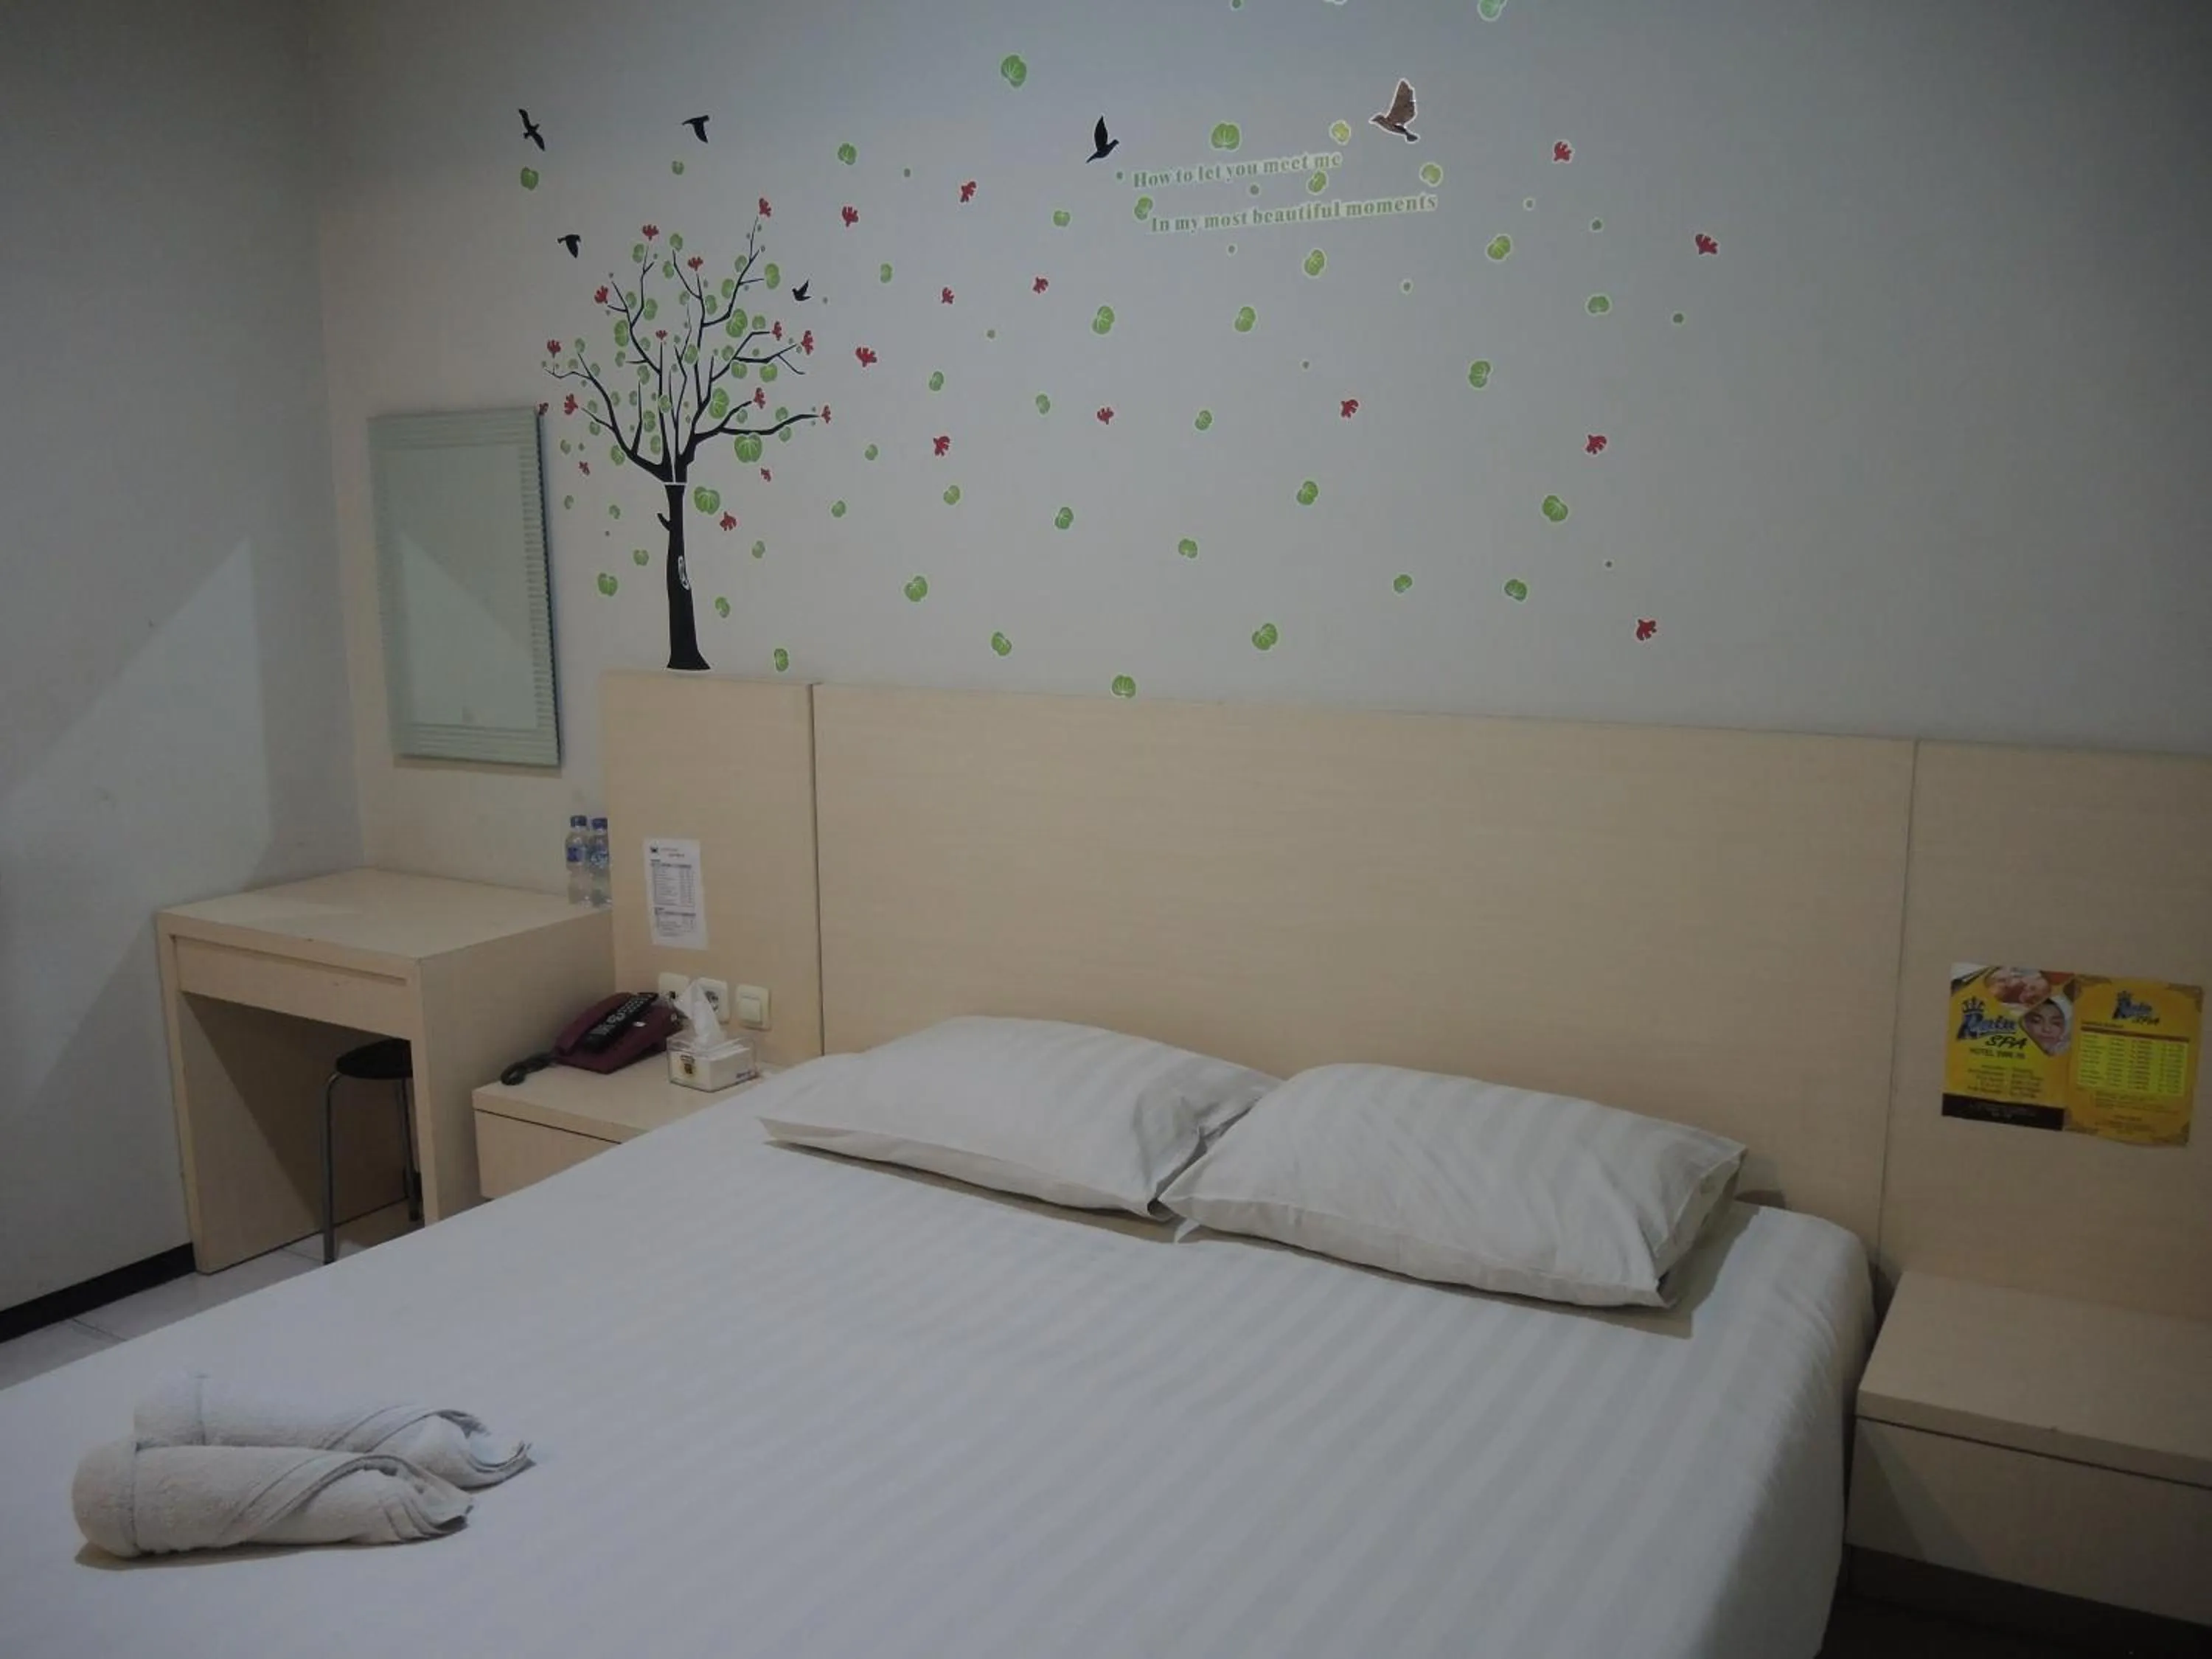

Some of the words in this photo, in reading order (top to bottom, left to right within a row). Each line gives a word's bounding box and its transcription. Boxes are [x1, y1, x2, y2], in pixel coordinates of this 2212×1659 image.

[1133, 170, 1170, 188] How
[1175, 169, 1193, 183] to
[1197, 165, 1220, 181] let
[1225, 162, 1257, 181] you
[1263, 154, 1308, 174] meet
[1314, 153, 1341, 169] me
[1151, 216, 1169, 233] In
[1175, 217, 1197, 235] my
[1203, 212, 1248, 229] most
[1253, 201, 1340, 225] beautiful
[1346, 194, 1437, 217] moments
[1985, 1034, 2028, 1049] SPA
